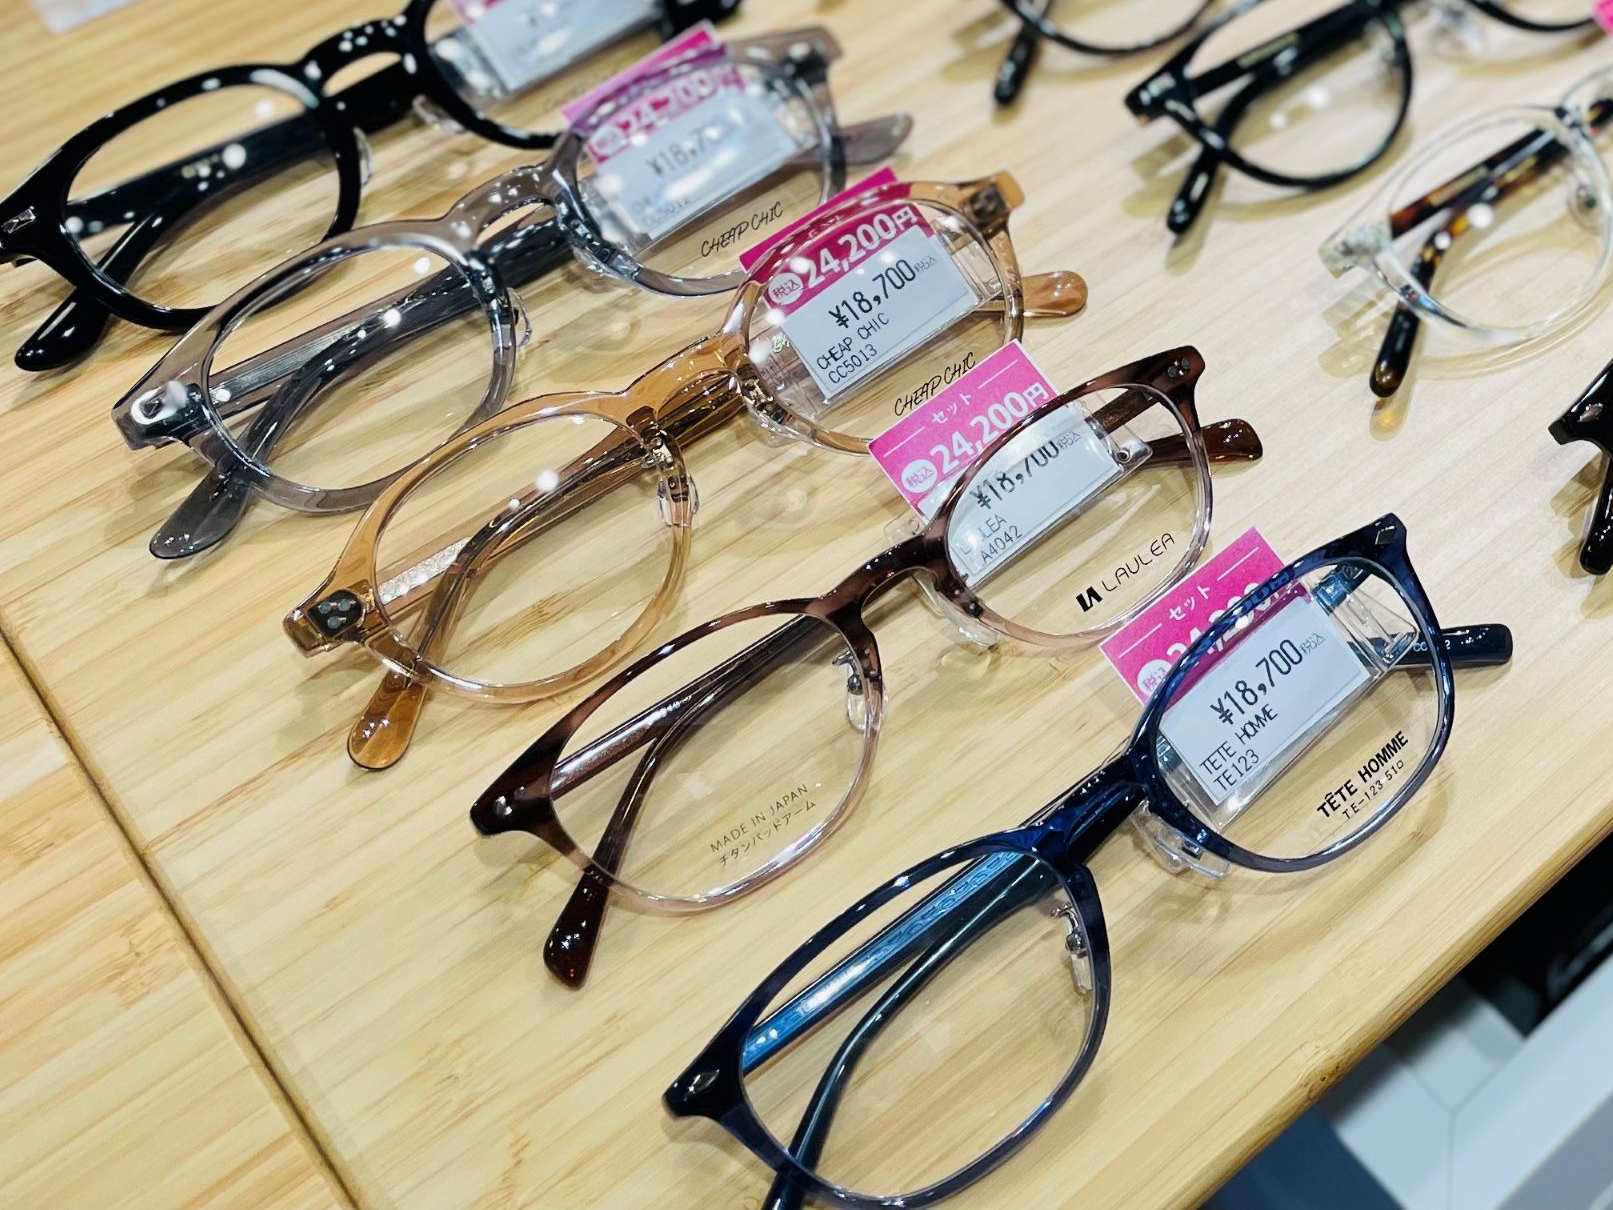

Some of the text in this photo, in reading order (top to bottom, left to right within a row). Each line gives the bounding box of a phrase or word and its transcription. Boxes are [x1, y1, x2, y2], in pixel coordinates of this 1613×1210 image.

[701, 221, 749, 257] CHEAP
[751, 201, 783, 231] CHIC
[807, 206, 918, 289] 24,200円
[816, 312, 891, 371] CHEAP CHIC
[828, 343, 878, 385] CC5013
[894, 351, 977, 417] CHEAP CHIC
[932, 392, 972, 424] セット
[930, 381, 1049, 475] 24,200円
[1101, 533, 1175, 592] LAULEA
[1169, 585, 1211, 621] セット
[1199, 703, 1279, 775] TETE HOMME
[1213, 748, 1260, 791] TE123
[1316, 730, 1409, 818] TÊTE HOMME
[709, 783, 808, 852] MADE IN JAPAN
